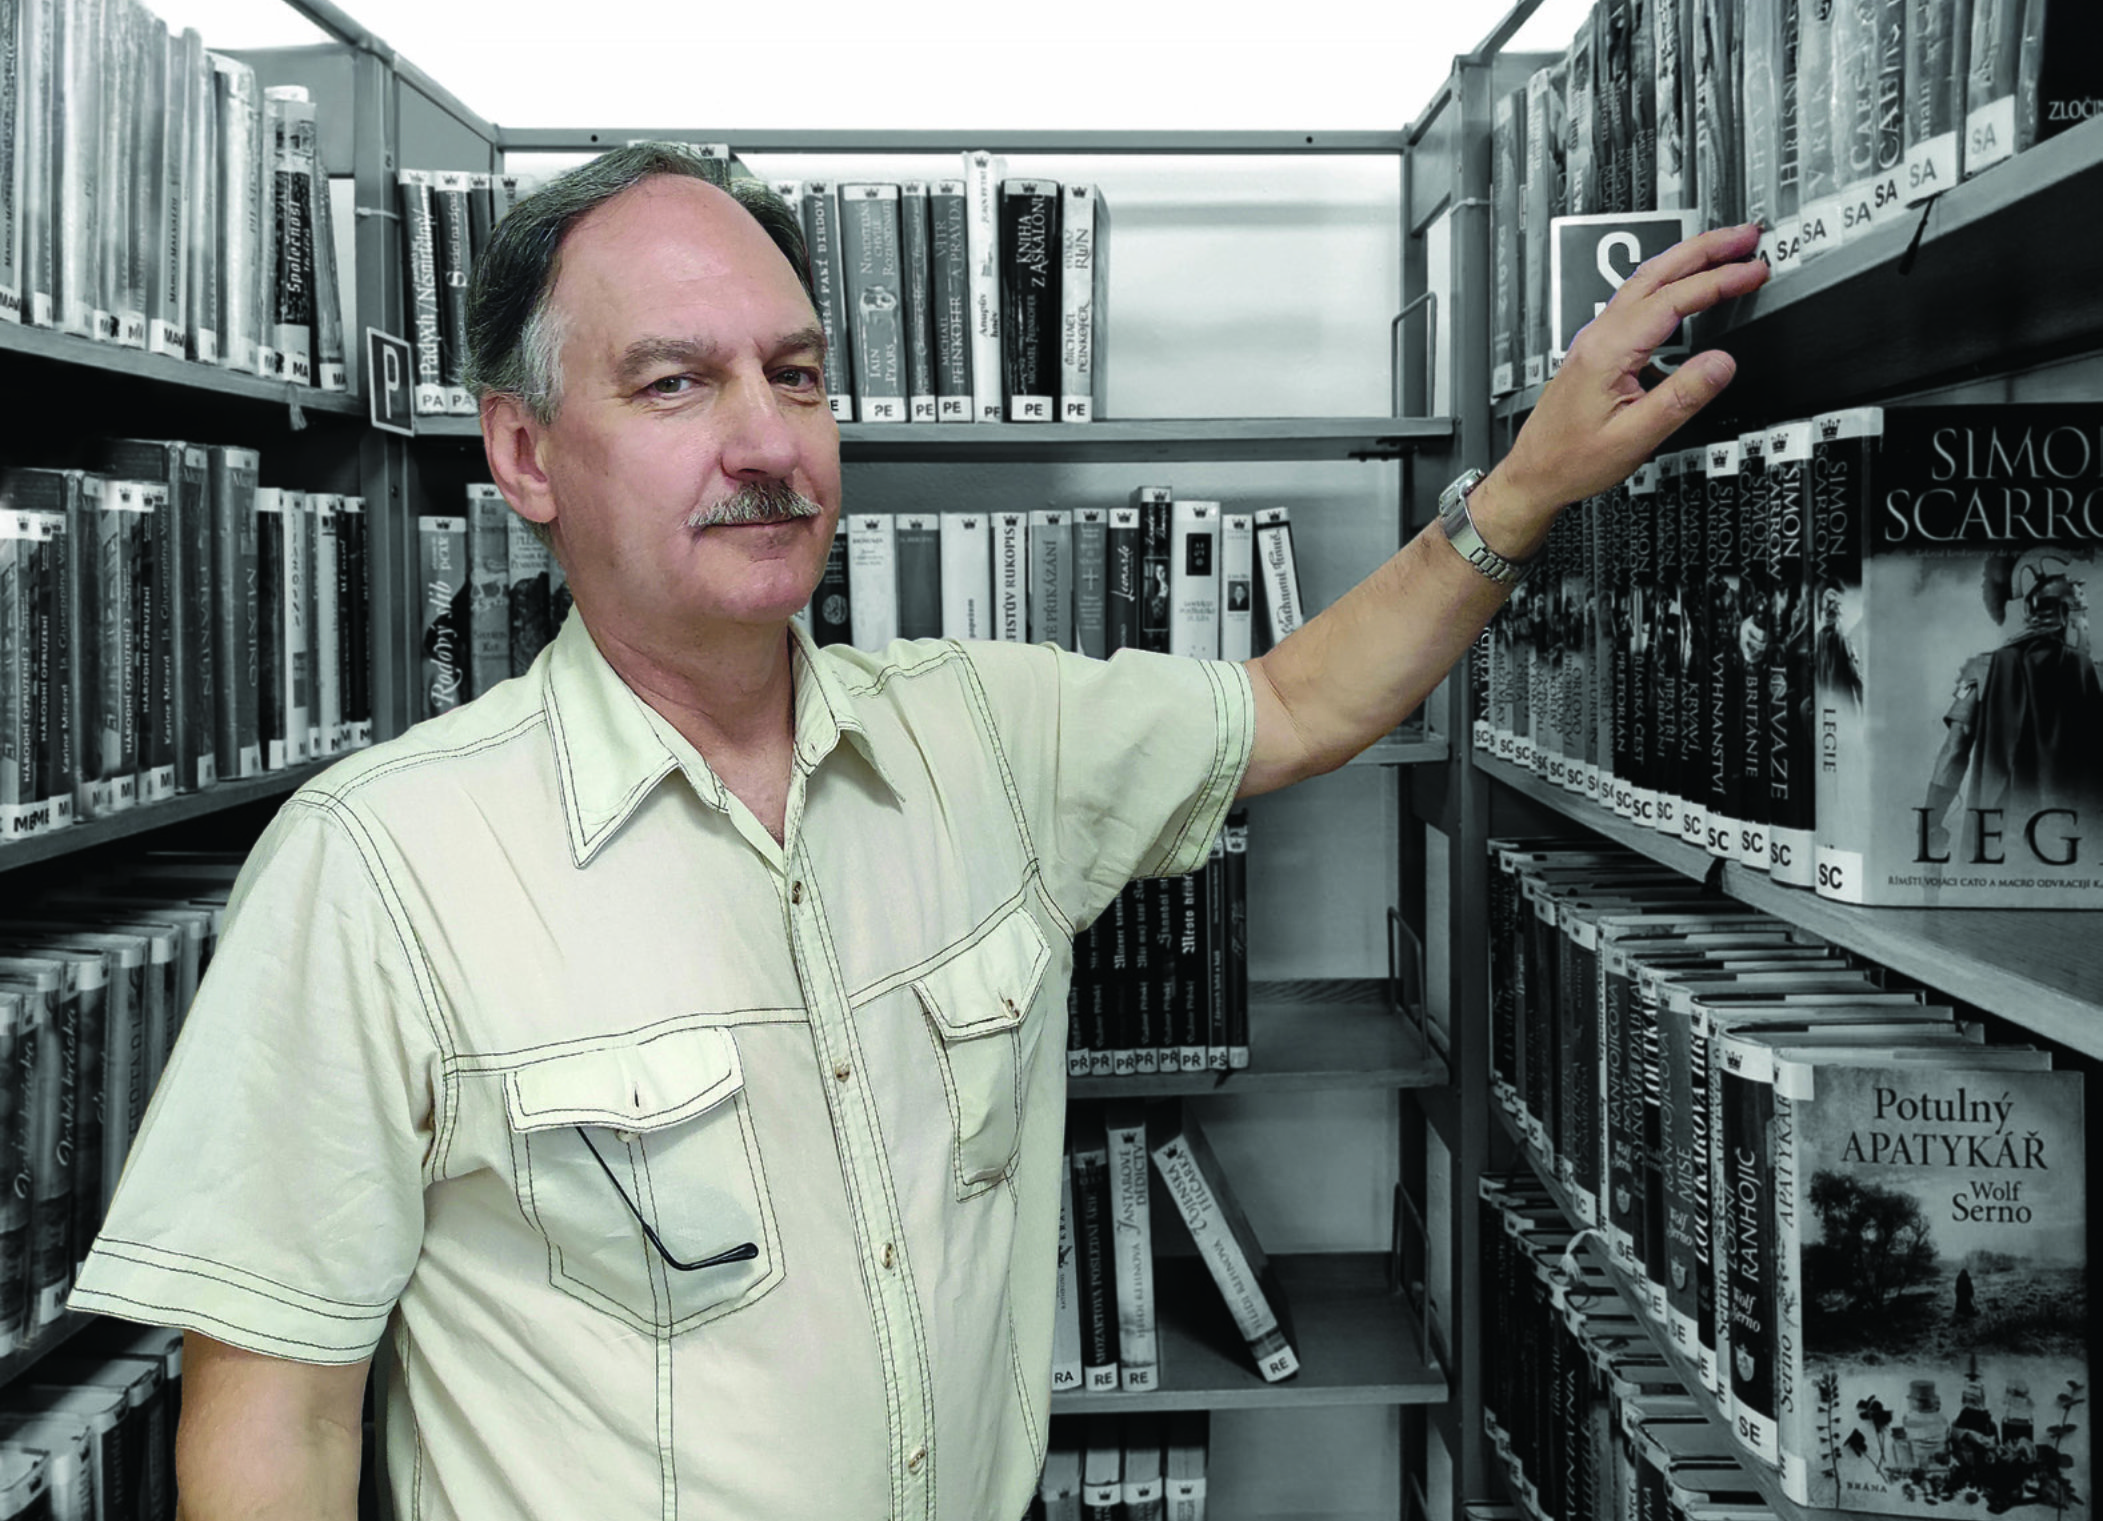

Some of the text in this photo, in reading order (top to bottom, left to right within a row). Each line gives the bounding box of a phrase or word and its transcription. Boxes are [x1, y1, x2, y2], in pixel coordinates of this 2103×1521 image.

[1971, 122, 1997, 154] SA
[1909, 157, 1937, 188] SA
[1875, 179, 1898, 208] SA
[948, 198, 963, 261] PRAVDA
[1844, 201, 1871, 228] SA
[1015, 214, 1032, 264] KNIHA
[1802, 218, 1826, 244] SA
[1074, 228, 1092, 270] RUN
[1777, 236, 1800, 261] SA
[1031, 277, 1046, 288] Z
[940, 315, 951, 366] MICHAEL
[949, 296, 965, 385] PEINKOFER
[1063, 312, 1076, 366] MICHAEL
[1077, 300, 1092, 373] PEINKOFER
[869, 347, 881, 378] IAIN
[884, 343, 897, 382] PEARS
[384, 344, 400, 420] P
[422, 394, 444, 406] PA
[874, 404, 893, 417] PE
[916, 403, 934, 416] PE
[943, 401, 961, 414] PE
[984, 405, 1000, 418] PE
[1024, 403, 1043, 416] PE
[1067, 403, 1085, 416] PE
[1931, 425, 2092, 483] SIMO
[1751, 475, 1767, 561] SIMON
[1782, 464, 1801, 559] SIMON
[1814, 443, 1829, 580] SCARROW
[1828, 459, 1847, 557] SIMON
[1638, 501, 1651, 573] SIMON
[1664, 492, 1678, 566] SIMON
[1718, 485, 1734, 567] SIMON
[1003, 527, 1017, 588] RUKOPIS
[1109, 544, 1136, 602] Leonardo
[1041, 540, 1058, 622] PŘIKÁZÁNÍ
[427, 579, 452, 619] slib
[246, 567, 259, 687] MEXIKO
[123, 629, 133, 691] OPRUZENÍ
[141, 585, 152, 713] NÁRODNÍ OPRUZENÍ
[428, 623, 463, 706] Rodový
[20, 658, 31, 719] OPRUZENÍ
[39, 615, 50, 742] NÁRODNÍ OPRUZENÍ
[123, 694, 133, 754] NÁRODNÍ
[1475, 730, 1489, 743] SC
[1709, 652, 1726, 794] VYHNANSTVÍ
[1744, 674, 1760, 777] BRITÁNIE
[20, 723, 31, 782] NÁRODNÍ
[1500, 738, 1514, 753] SC
[1516, 746, 1530, 760] SC
[1821, 707, 1837, 774] LEGIE
[1550, 762, 1565, 777] SC
[1567, 769, 1584, 786] SC
[1616, 790, 1632, 809] SC
[1633, 799, 1653, 819] SC
[1657, 801, 1673, 820] SC
[1683, 814, 1701, 835] SC
[1707, 827, 1729, 851] SC
[1911, 806, 2103, 867] LEG
[1742, 830, 1763, 853] SC
[1770, 842, 1792, 866] SC
[1818, 863, 1843, 889] SC
[1960, 878, 1987, 888] CATO
[1988, 878, 1997, 888] A
[1999, 878, 2035, 888] MACRO
[1071, 1056, 1089, 1071] PŘ
[1091, 1054, 1111, 1068] PŘ
[1115, 1056, 1135, 1070] PŘ
[1136, 1051, 1155, 1066] PŘ
[1160, 1050, 1180, 1064] PŘ
[1182, 1051, 1201, 1068] PŘ
[1209, 1051, 1228, 1067] PŠ
[1873, 1087, 2015, 1136] Potulný
[1840, 1130, 2048, 1170] APATYKÁŘ
[1677, 1147, 1693, 1202] MISE
[1969, 1180, 2022, 1202] Wolf
[1739, 1147, 1761, 1282] RANHOJIČ
[1951, 1192, 2032, 1223] Serno
[1617, 1239, 1633, 1262] SE
[1669, 1317, 1686, 1344] SE
[1054, 1371, 1074, 1384] RA
[1094, 1371, 1112, 1385] RE
[1129, 1371, 1148, 1385] RE
[1269, 1357, 1289, 1374] RE
[1780, 1334, 1793, 1413] Serno
[1738, 1415, 1761, 1447] SE
